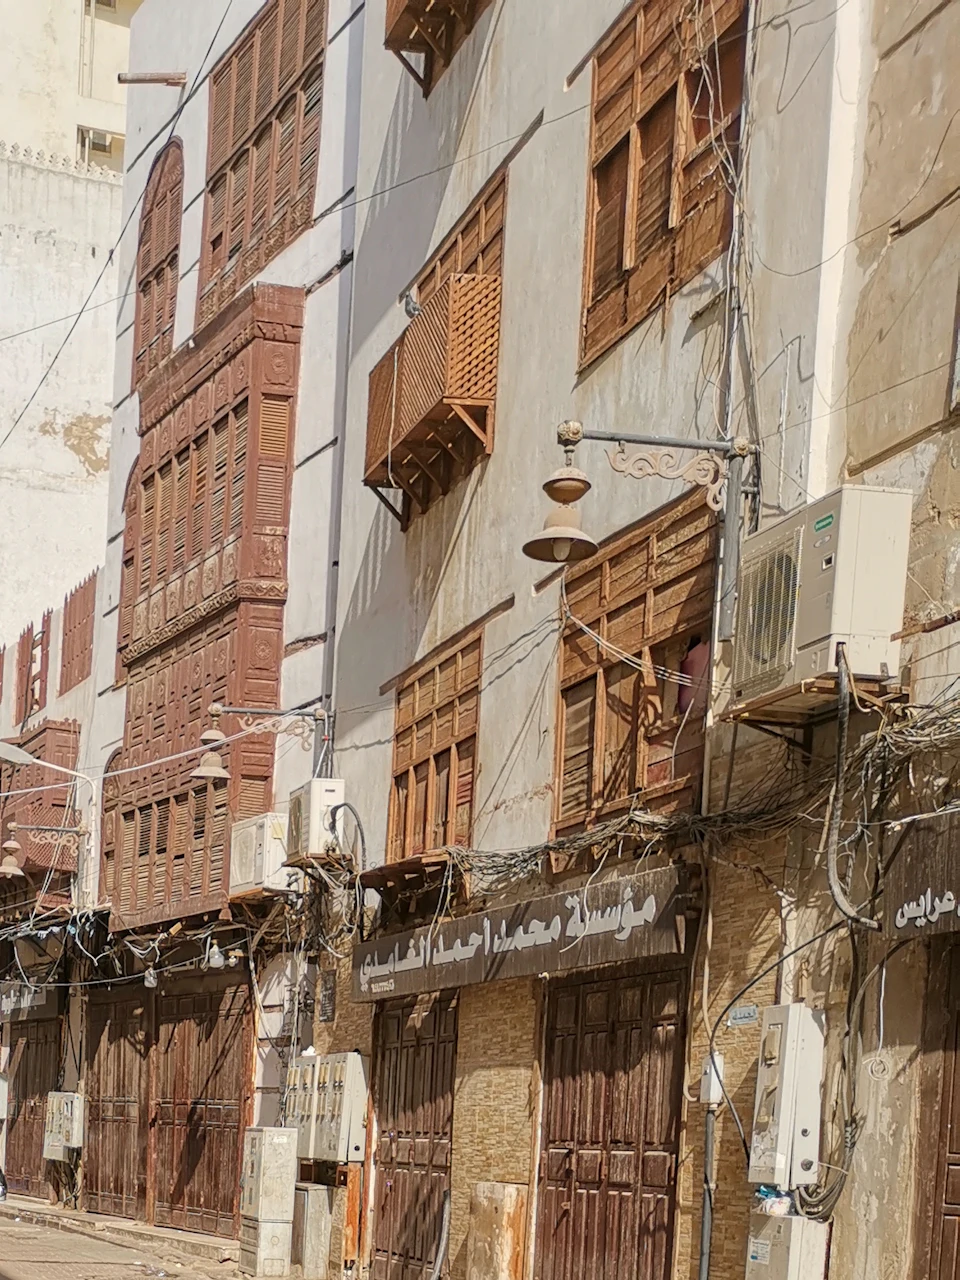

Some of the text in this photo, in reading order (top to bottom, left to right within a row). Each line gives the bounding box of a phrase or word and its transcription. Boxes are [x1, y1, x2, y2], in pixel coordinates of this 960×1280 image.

[565, 886, 656, 941] مؤسسة
[895, 887, 956, 929] عرايس
[493, 914, 561, 954] محمد
[360, 935, 431, 993] الغامدي
